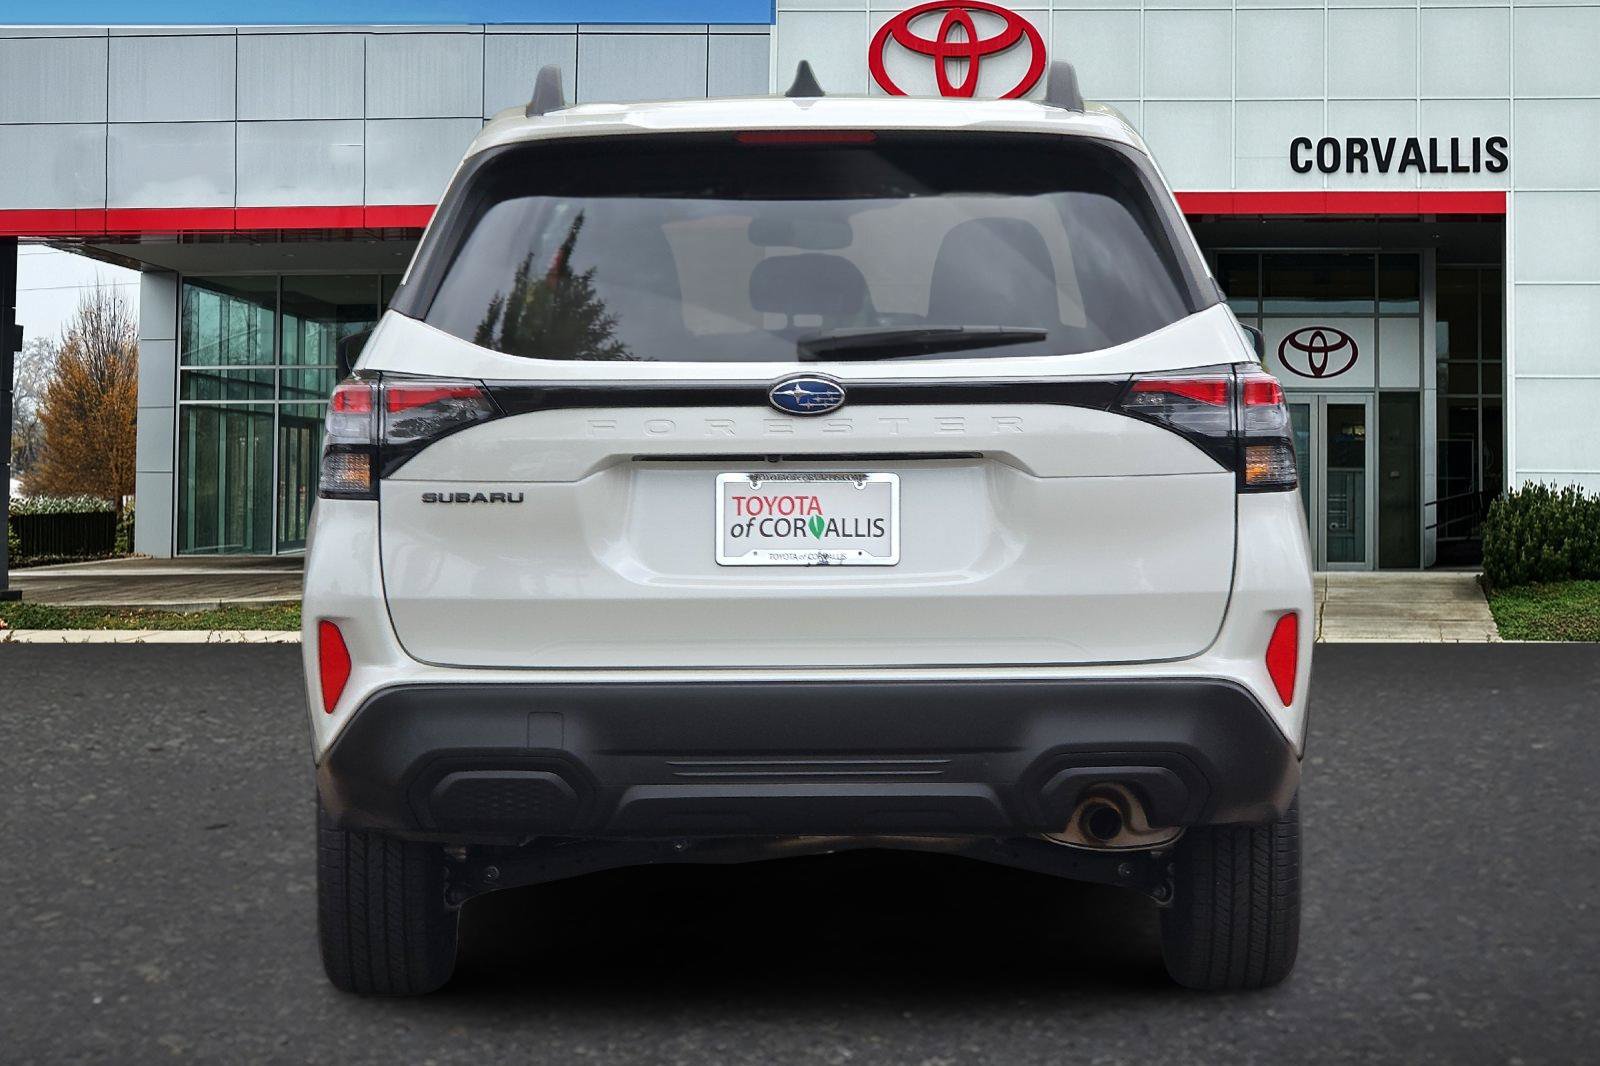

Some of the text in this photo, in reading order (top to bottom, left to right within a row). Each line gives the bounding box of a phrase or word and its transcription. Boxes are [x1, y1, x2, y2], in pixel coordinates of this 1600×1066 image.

[1290, 136, 1509, 174] CORVALLIS
[586, 415, 1026, 438] FORESTER
[421, 492, 525, 504] SUBARU
[731, 495, 824, 516] TOYOTA
[730, 517, 757, 538] of
[769, 553, 798, 561] TOYOTA
